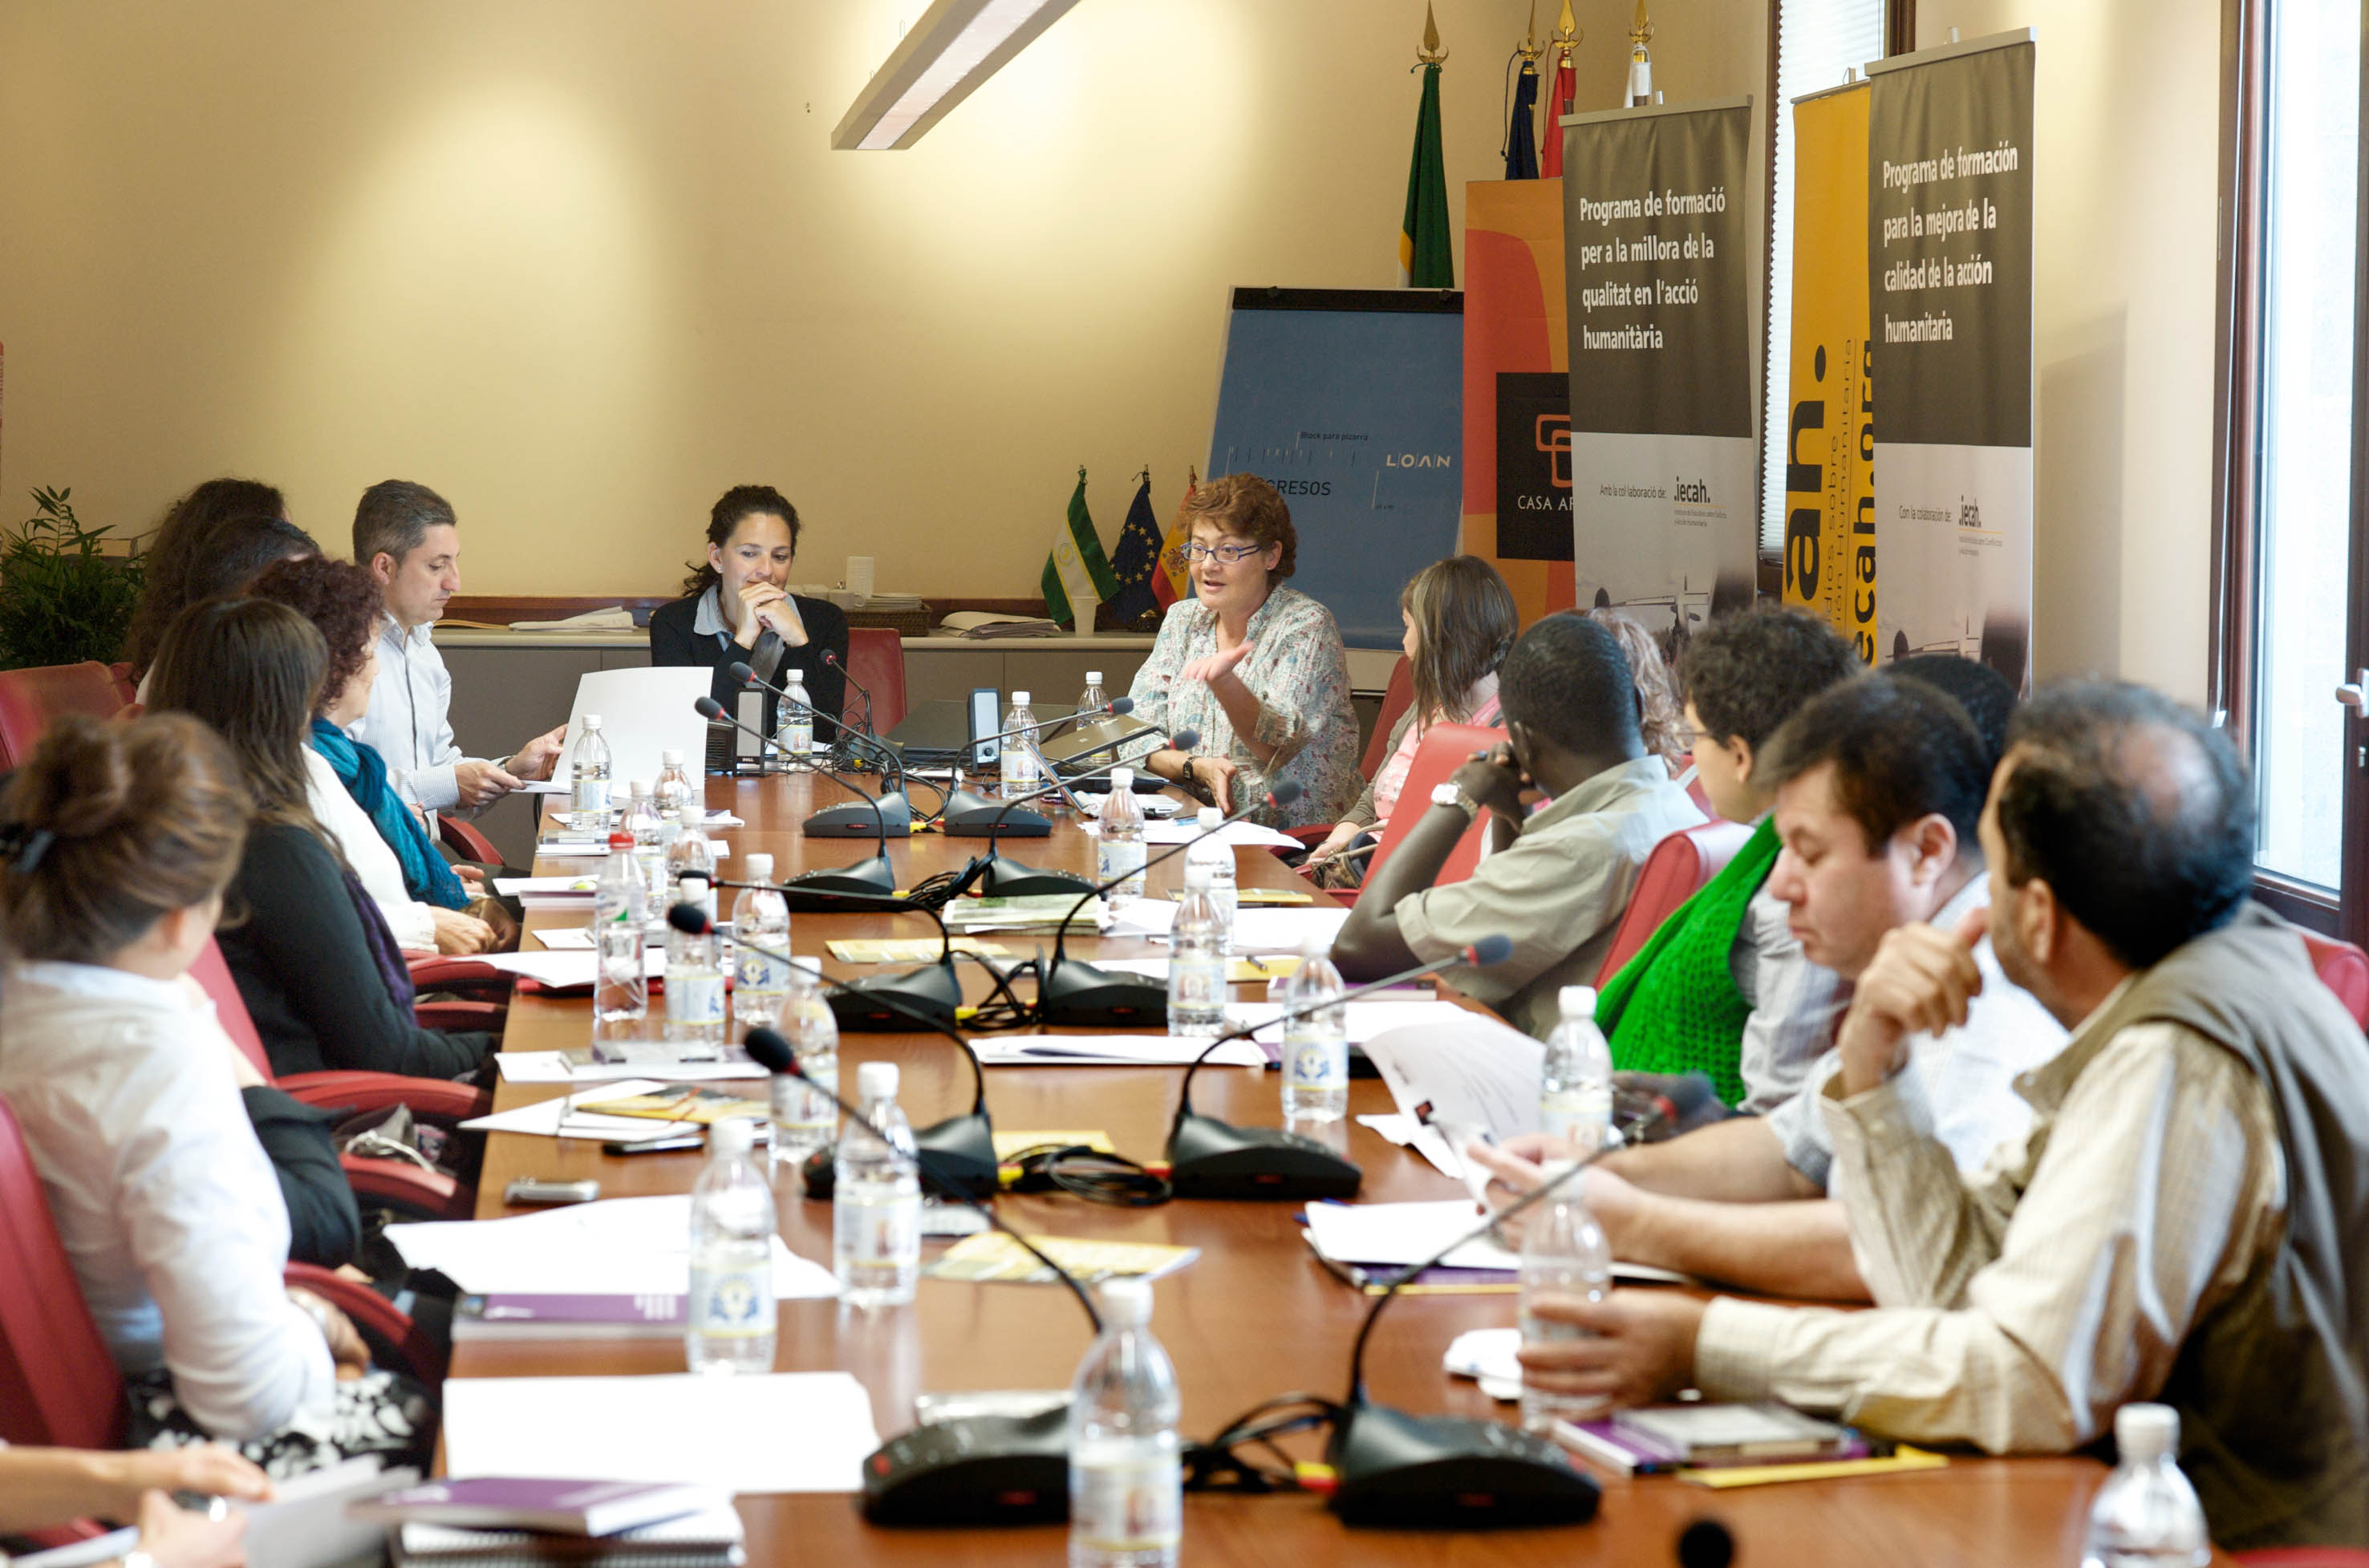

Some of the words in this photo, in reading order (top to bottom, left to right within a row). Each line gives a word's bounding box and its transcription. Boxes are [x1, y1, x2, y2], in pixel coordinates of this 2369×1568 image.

[1884, 160, 1937, 193] Programa
[1940, 148, 1955, 180] de
[1957, 140, 2018, 178] formación
[1580, 198, 1641, 226] Programa
[1645, 191, 1662, 217] de
[1665, 187, 1726, 215] formació
[1884, 216, 1908, 248] para
[1911, 206, 1923, 237] la
[1926, 203, 1964, 242] mejora
[1965, 199, 1979, 231] de
[1983, 197, 1997, 229] la
[1581, 245, 1603, 270] per
[1605, 247, 1612, 263] a
[1616, 237, 1628, 262] la
[1631, 235, 1679, 262] millora
[1684, 233, 1698, 259] de
[1702, 233, 1714, 258] la
[1884, 258, 1925, 292] calidad
[1928, 257, 1941, 289] de
[1944, 257, 1954, 287] la
[1957, 253, 1993, 286] acción
[1582, 282, 1632, 313] qualitat
[1634, 286, 1652, 306] en
[1657, 278, 1698, 305] l'acció
[1584, 324, 1663, 350] humanitària
[1885, 310, 1953, 343] humanitaria
[1300, 431, 1320, 440] Block
[1323, 433, 1341, 442] para
[1341, 433, 1369, 442] pizarra
[1836, 340, 1851, 555] Humanitaria
[1600, 483, 1612, 496] Amb
[1827, 436, 1838, 530] sobre
[1518, 495, 1552, 511] CASA
[1899, 505, 1909, 520] Con
